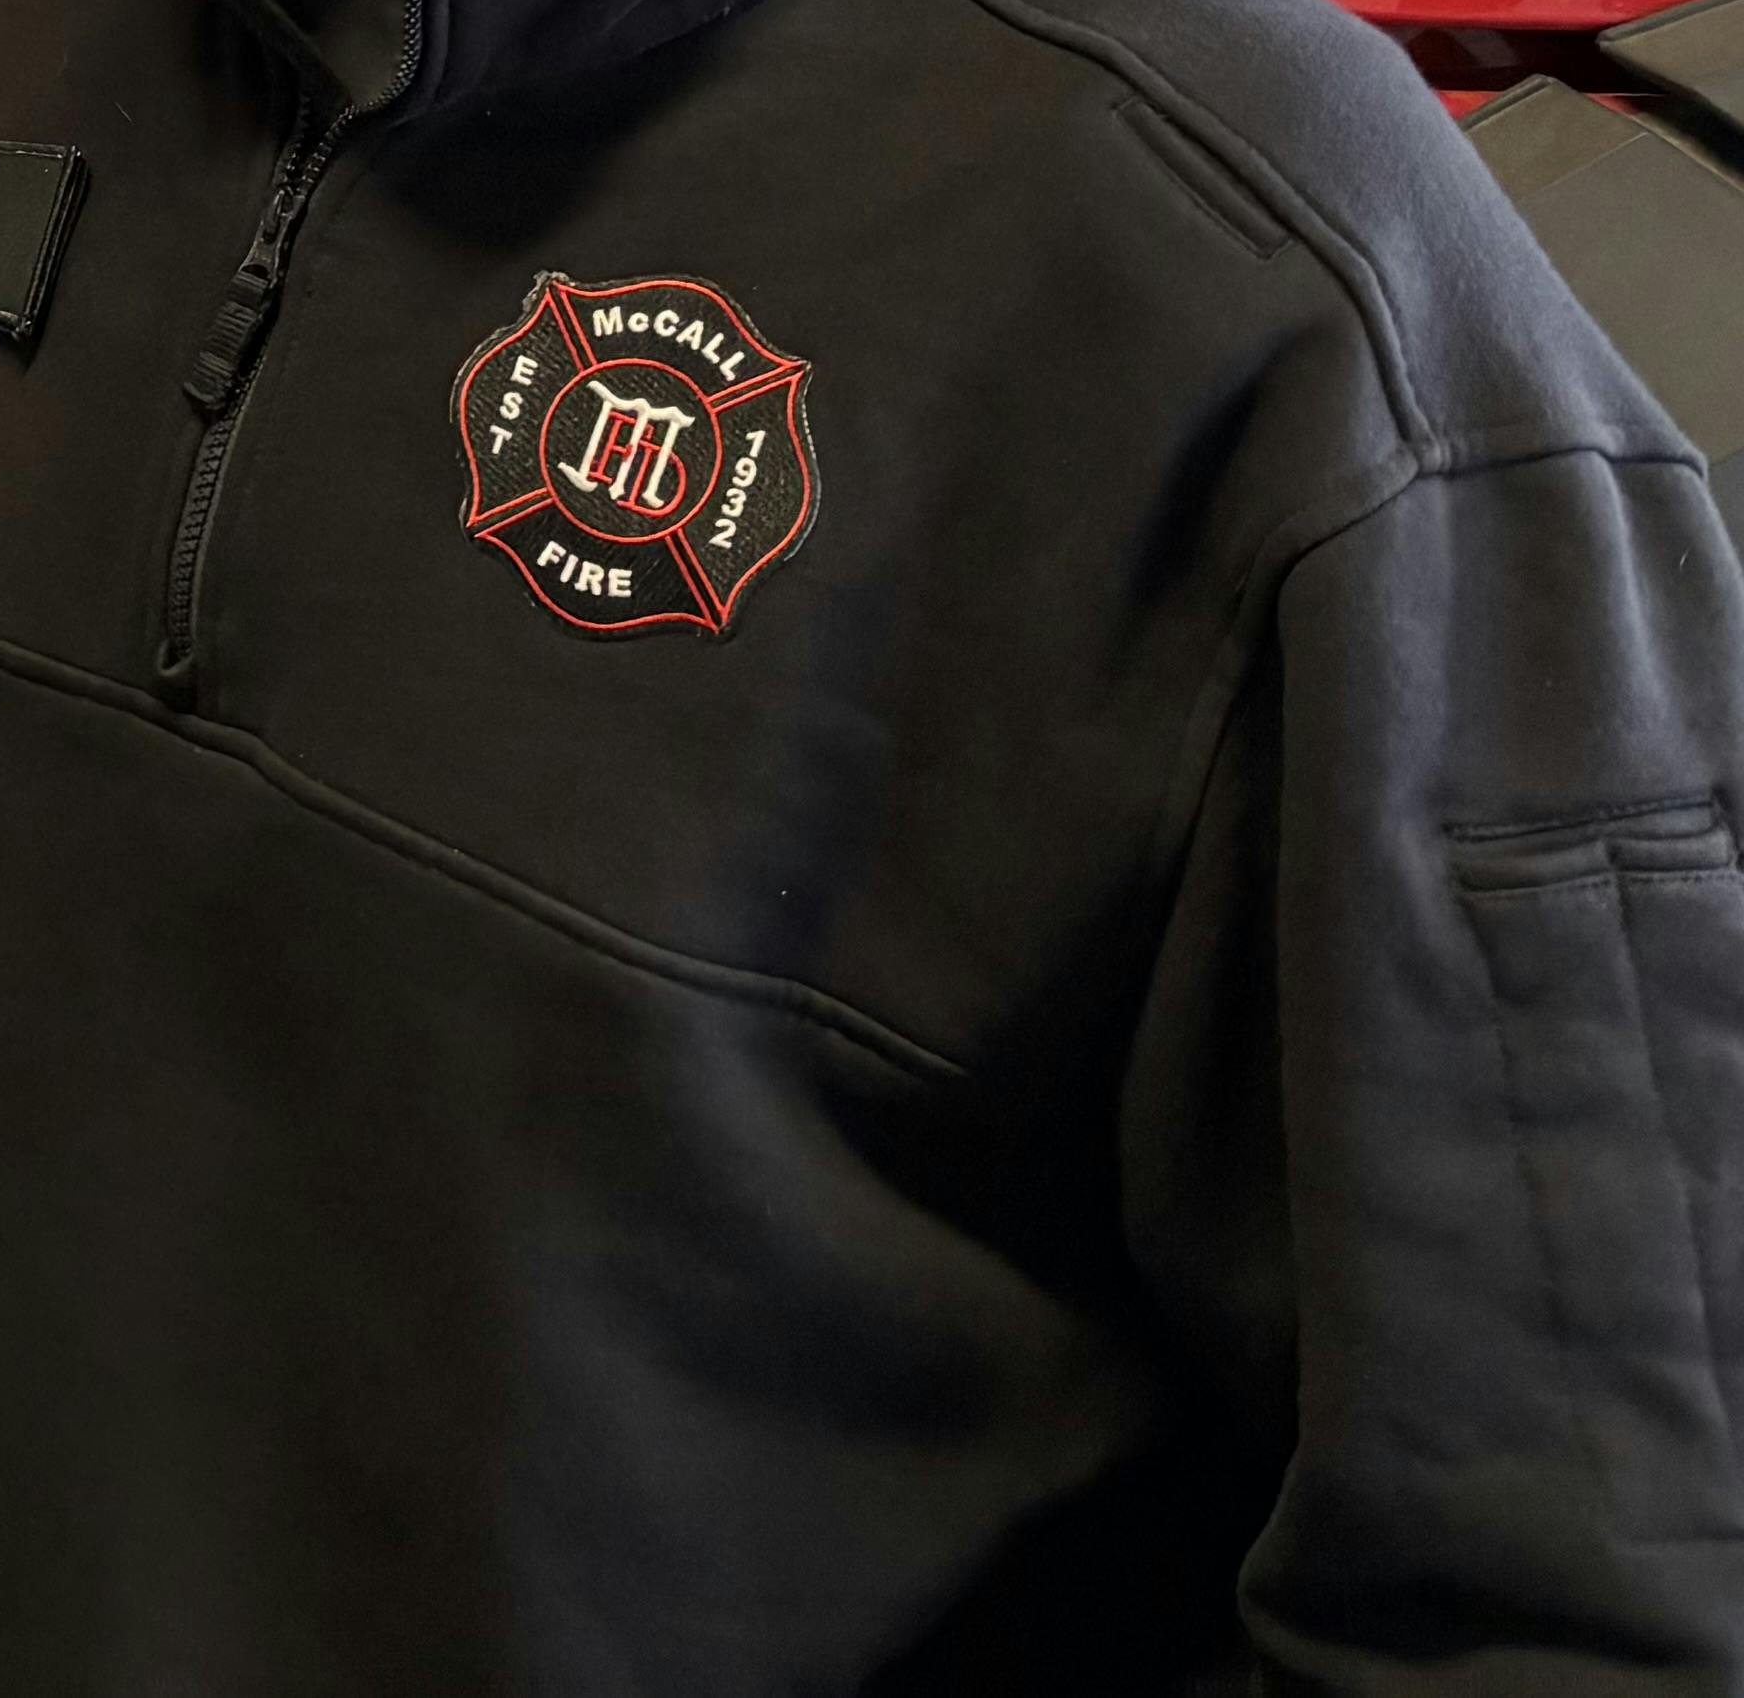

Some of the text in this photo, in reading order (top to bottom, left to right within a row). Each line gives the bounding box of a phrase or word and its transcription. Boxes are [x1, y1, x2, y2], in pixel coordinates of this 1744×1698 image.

[591, 305, 747, 382] McCALL
[487, 354, 539, 456] EST
[707, 429, 767, 550] 1932
[536, 539, 634, 598] FIRE
